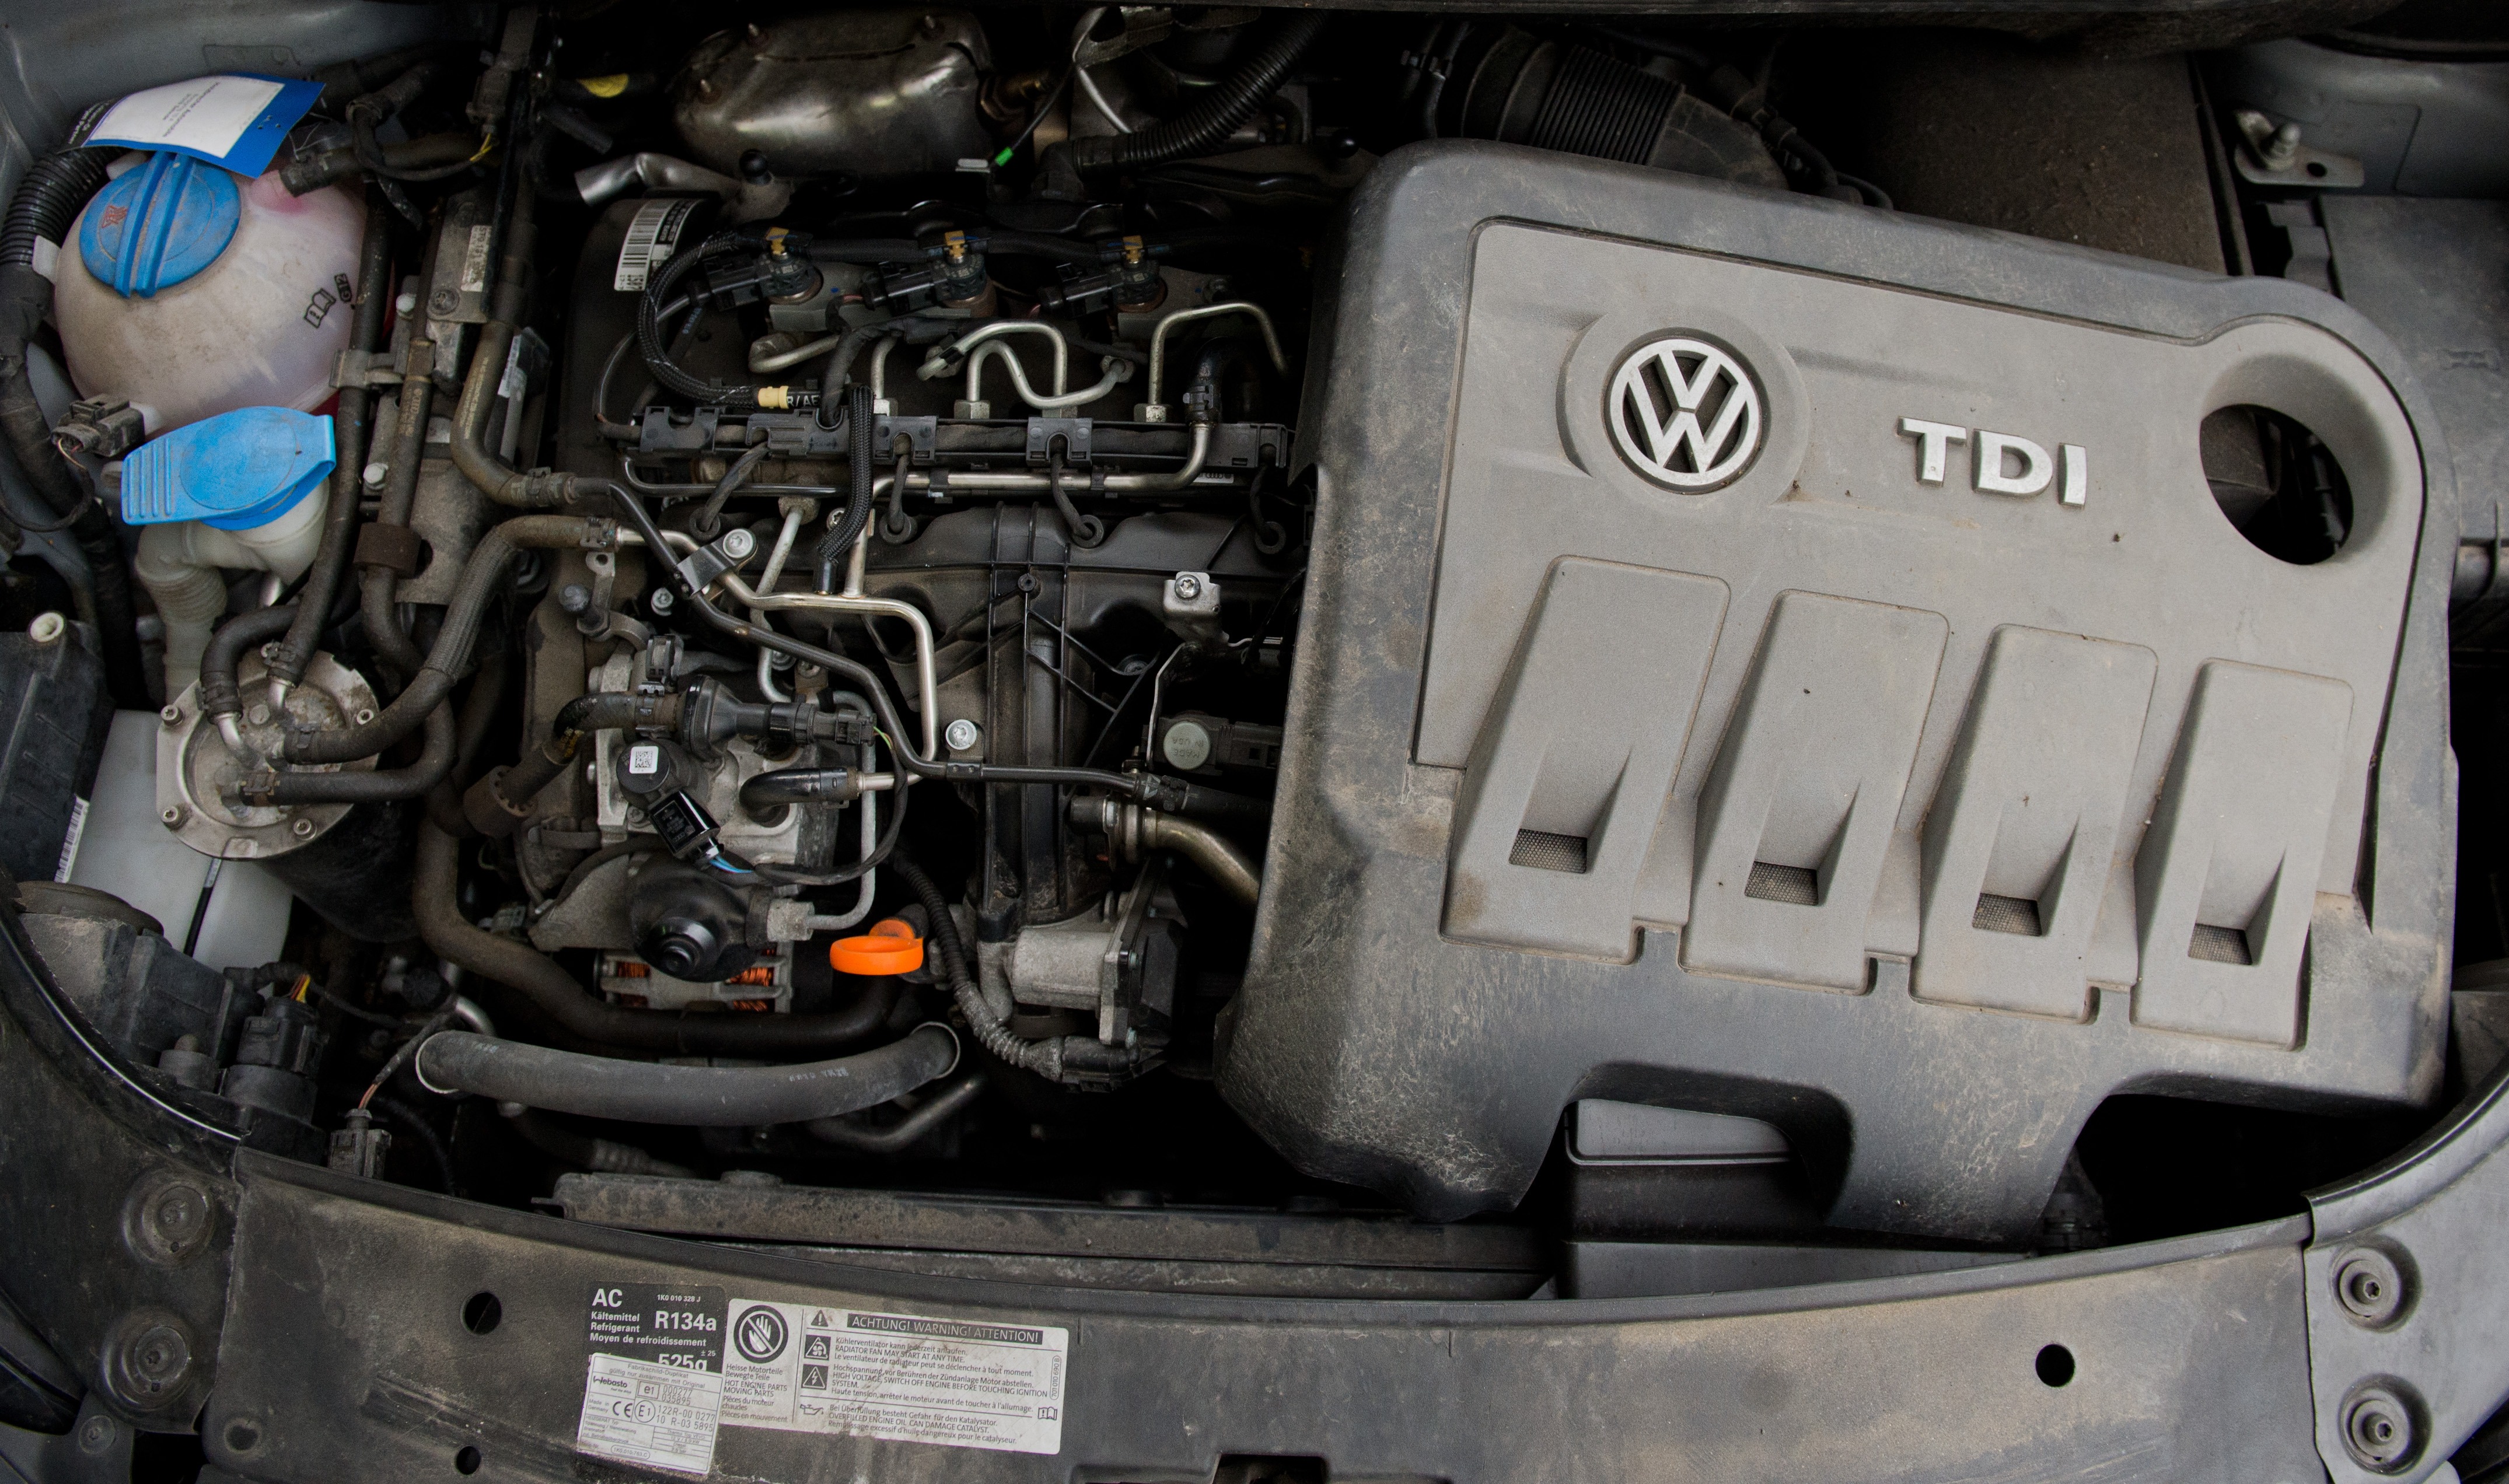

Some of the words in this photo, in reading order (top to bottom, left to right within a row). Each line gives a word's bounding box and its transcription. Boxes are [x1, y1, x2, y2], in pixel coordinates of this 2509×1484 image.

[1610, 338, 1761, 486] VW
[1896, 415, 2087, 509] TDI
[592, 1288, 623, 1307] AC
[591, 1311, 640, 1322] Kältemittel
[655, 1311, 717, 1331] R134a
[590, 1322, 640, 1333] Refrigerant
[852, 1317, 910, 1331] ACHTUNG!
[914, 1322, 971, 1336] WARNING!
[974, 1328, 1038, 1342] ATTENTION!
[590, 1333, 620, 1343] Moyen
[623, 1335, 634, 1343] de
[637, 1335, 707, 1346] refroidissement
[836, 1337, 889, 1348] Kühlerventilator
[907, 1343, 935, 1353] jederzeit
[936, 1346, 967, 1355] anlaufen.
[835, 1345, 868, 1354] RADIATOR
[628, 1363, 689, 1379] Fabrikschild-Duplikat
[726, 1364, 747, 1372] Heisse
[749, 1366, 783, 1375] Motorteile
[843, 1354, 879, 1363] ventilateur
[889, 1357, 919, 1367] radiateur
[920, 1361, 936, 1370] peut
[946, 1363, 981, 1373] déclencher
[1004, 1369, 1034, 1377] moment.
[638, 1373, 669, 1383] zusammen
[683, 1380, 705, 1389] Original
[726, 1370, 754, 1380] Bewegte
[897, 1370, 927, 1379] Berühren
[940, 1374, 979, 1385] Zündanlage
[980, 1377, 1001, 1385] Motor
[1002, 1379, 1034, 1388] abstellen.
[593, 1376, 628, 1388] Webasto
[768, 1383, 787, 1391] PARTS
[832, 1380, 859, 1388] SYSTEM.
[833, 1371, 850, 1380] HIGH
[852, 1374, 883, 1384] VOLTAGE,
[883, 1377, 910, 1385] SWITCH
[925, 1380, 951, 1390] ENGINE
[952, 1382, 977, 1391] BEFORE
[979, 1385, 1015, 1395] TOUCHING
[1016, 1388, 1047, 1397] IGNITION
[644, 1386, 655, 1395] e1
[663, 1385, 693, 1396] 000277
[724, 1387, 752, 1395] MOVING
[754, 1389, 774, 1397] PARTS
[662, 1394, 691, 1406] 035895
[724, 1395, 741, 1403] Pièces
[852, 1390, 879, 1399] tension,
[879, 1392, 901, 1400] arrêter
[965, 1400, 991, 1409] toucher
[997, 1402, 1033, 1413] l'allumage.
[588, 1405, 609, 1413] Germany
[841, 1404, 880, 1417] Überfüllung
[882, 1410, 907, 1418] besteht
[908, 1412, 931, 1420] Gefahr
[945, 1414, 958, 1422] den
[959, 1415, 998, 1426] Katalysator.
[696, 1410, 715, 1423] 0277
[721, 1410, 740, 1419] Pièces
[750, 1414, 788, 1422] mouvement
[656, 1415, 665, 1424] 10
[671, 1418, 691, 1429] R-03
[694, 1421, 713, 1432] 5895
[829, 1413, 868, 1422] OVERFILLED
[869, 1416, 894, 1424] ENGINE
[925, 1422, 956, 1430] DAMAGE
[957, 1424, 990, 1433] CATALYST.
[829, 1420, 869, 1431] Remplissage
[870, 1424, 896, 1433] excessif
[897, 1426, 920, 1434] d'huile
[921, 1429, 956, 1438] dangereux
[981, 1435, 1017, 1444] catalyseur.
